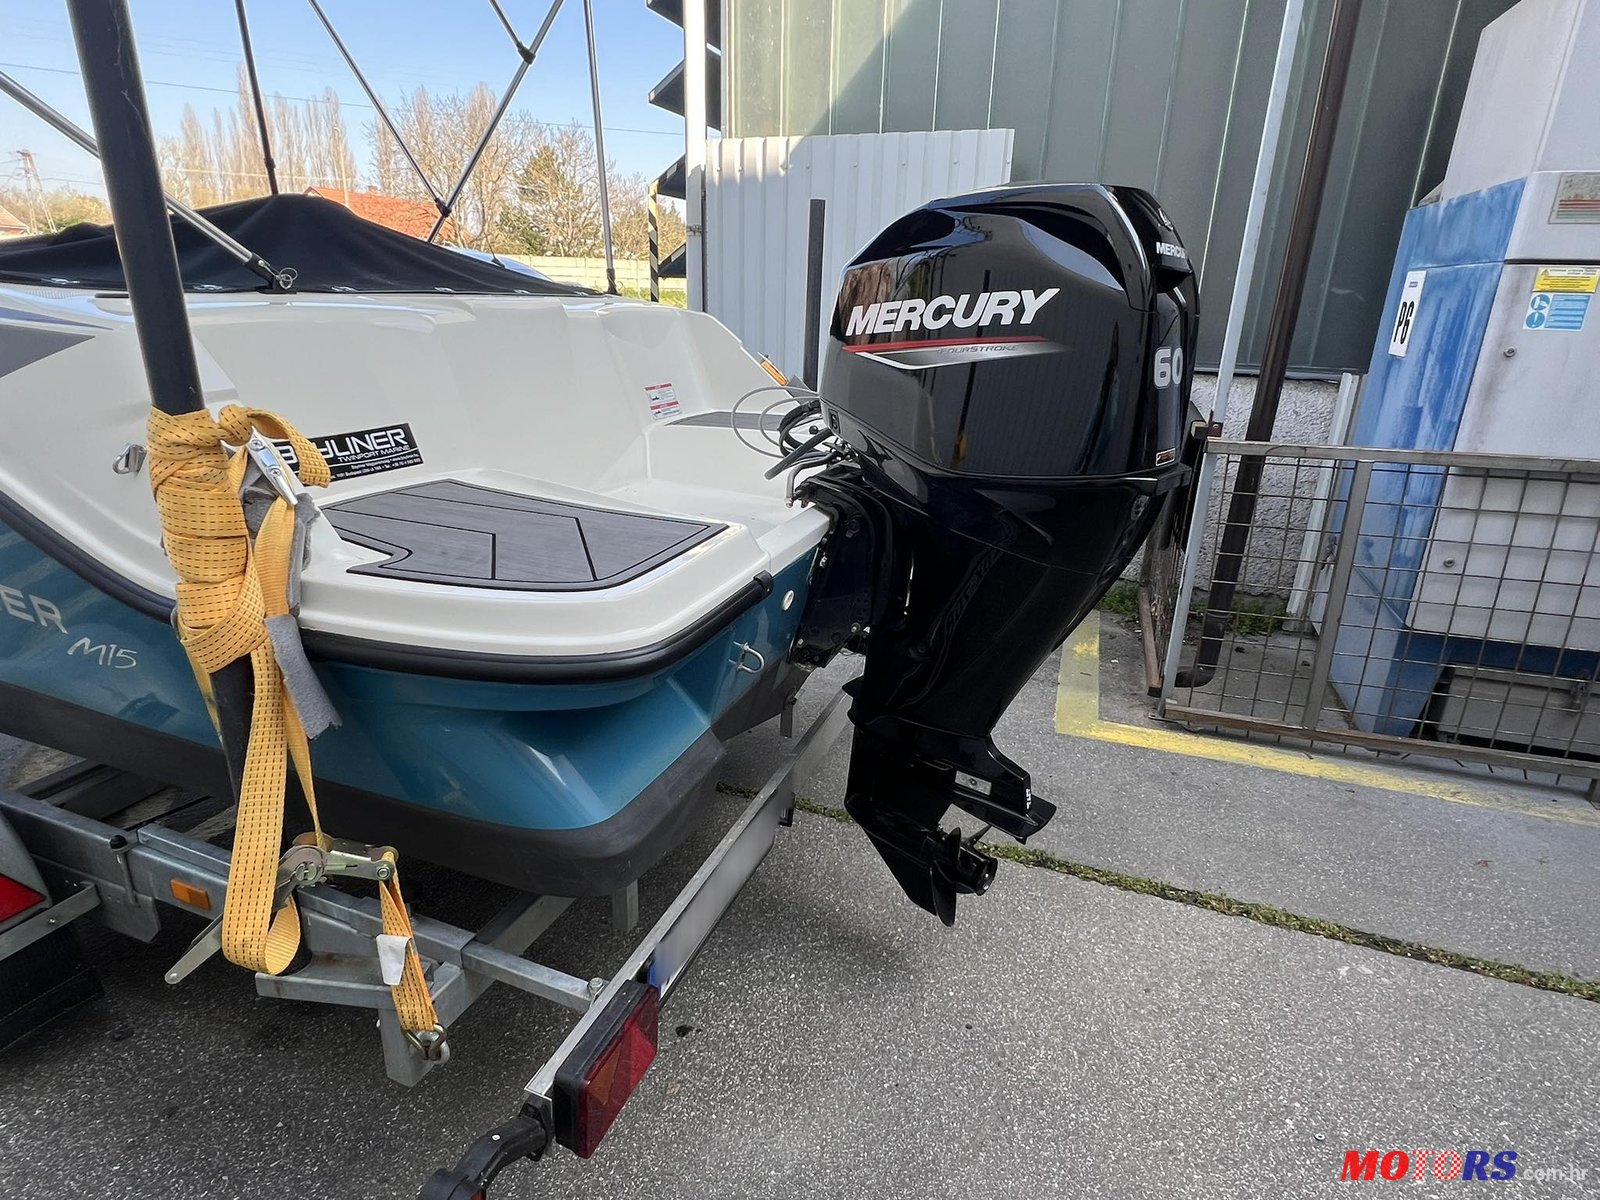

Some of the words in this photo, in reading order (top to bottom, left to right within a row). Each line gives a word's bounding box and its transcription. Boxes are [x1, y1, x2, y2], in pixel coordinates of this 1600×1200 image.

[845, 287, 1061, 337] MERCURY
[1154, 347, 1183, 389] 60
[276, 428, 409, 465] BYLINER
[337, 450, 380, 463] TWINPORT
[380, 445, 411, 456] MARINE
[67, 637, 137, 669] M15
